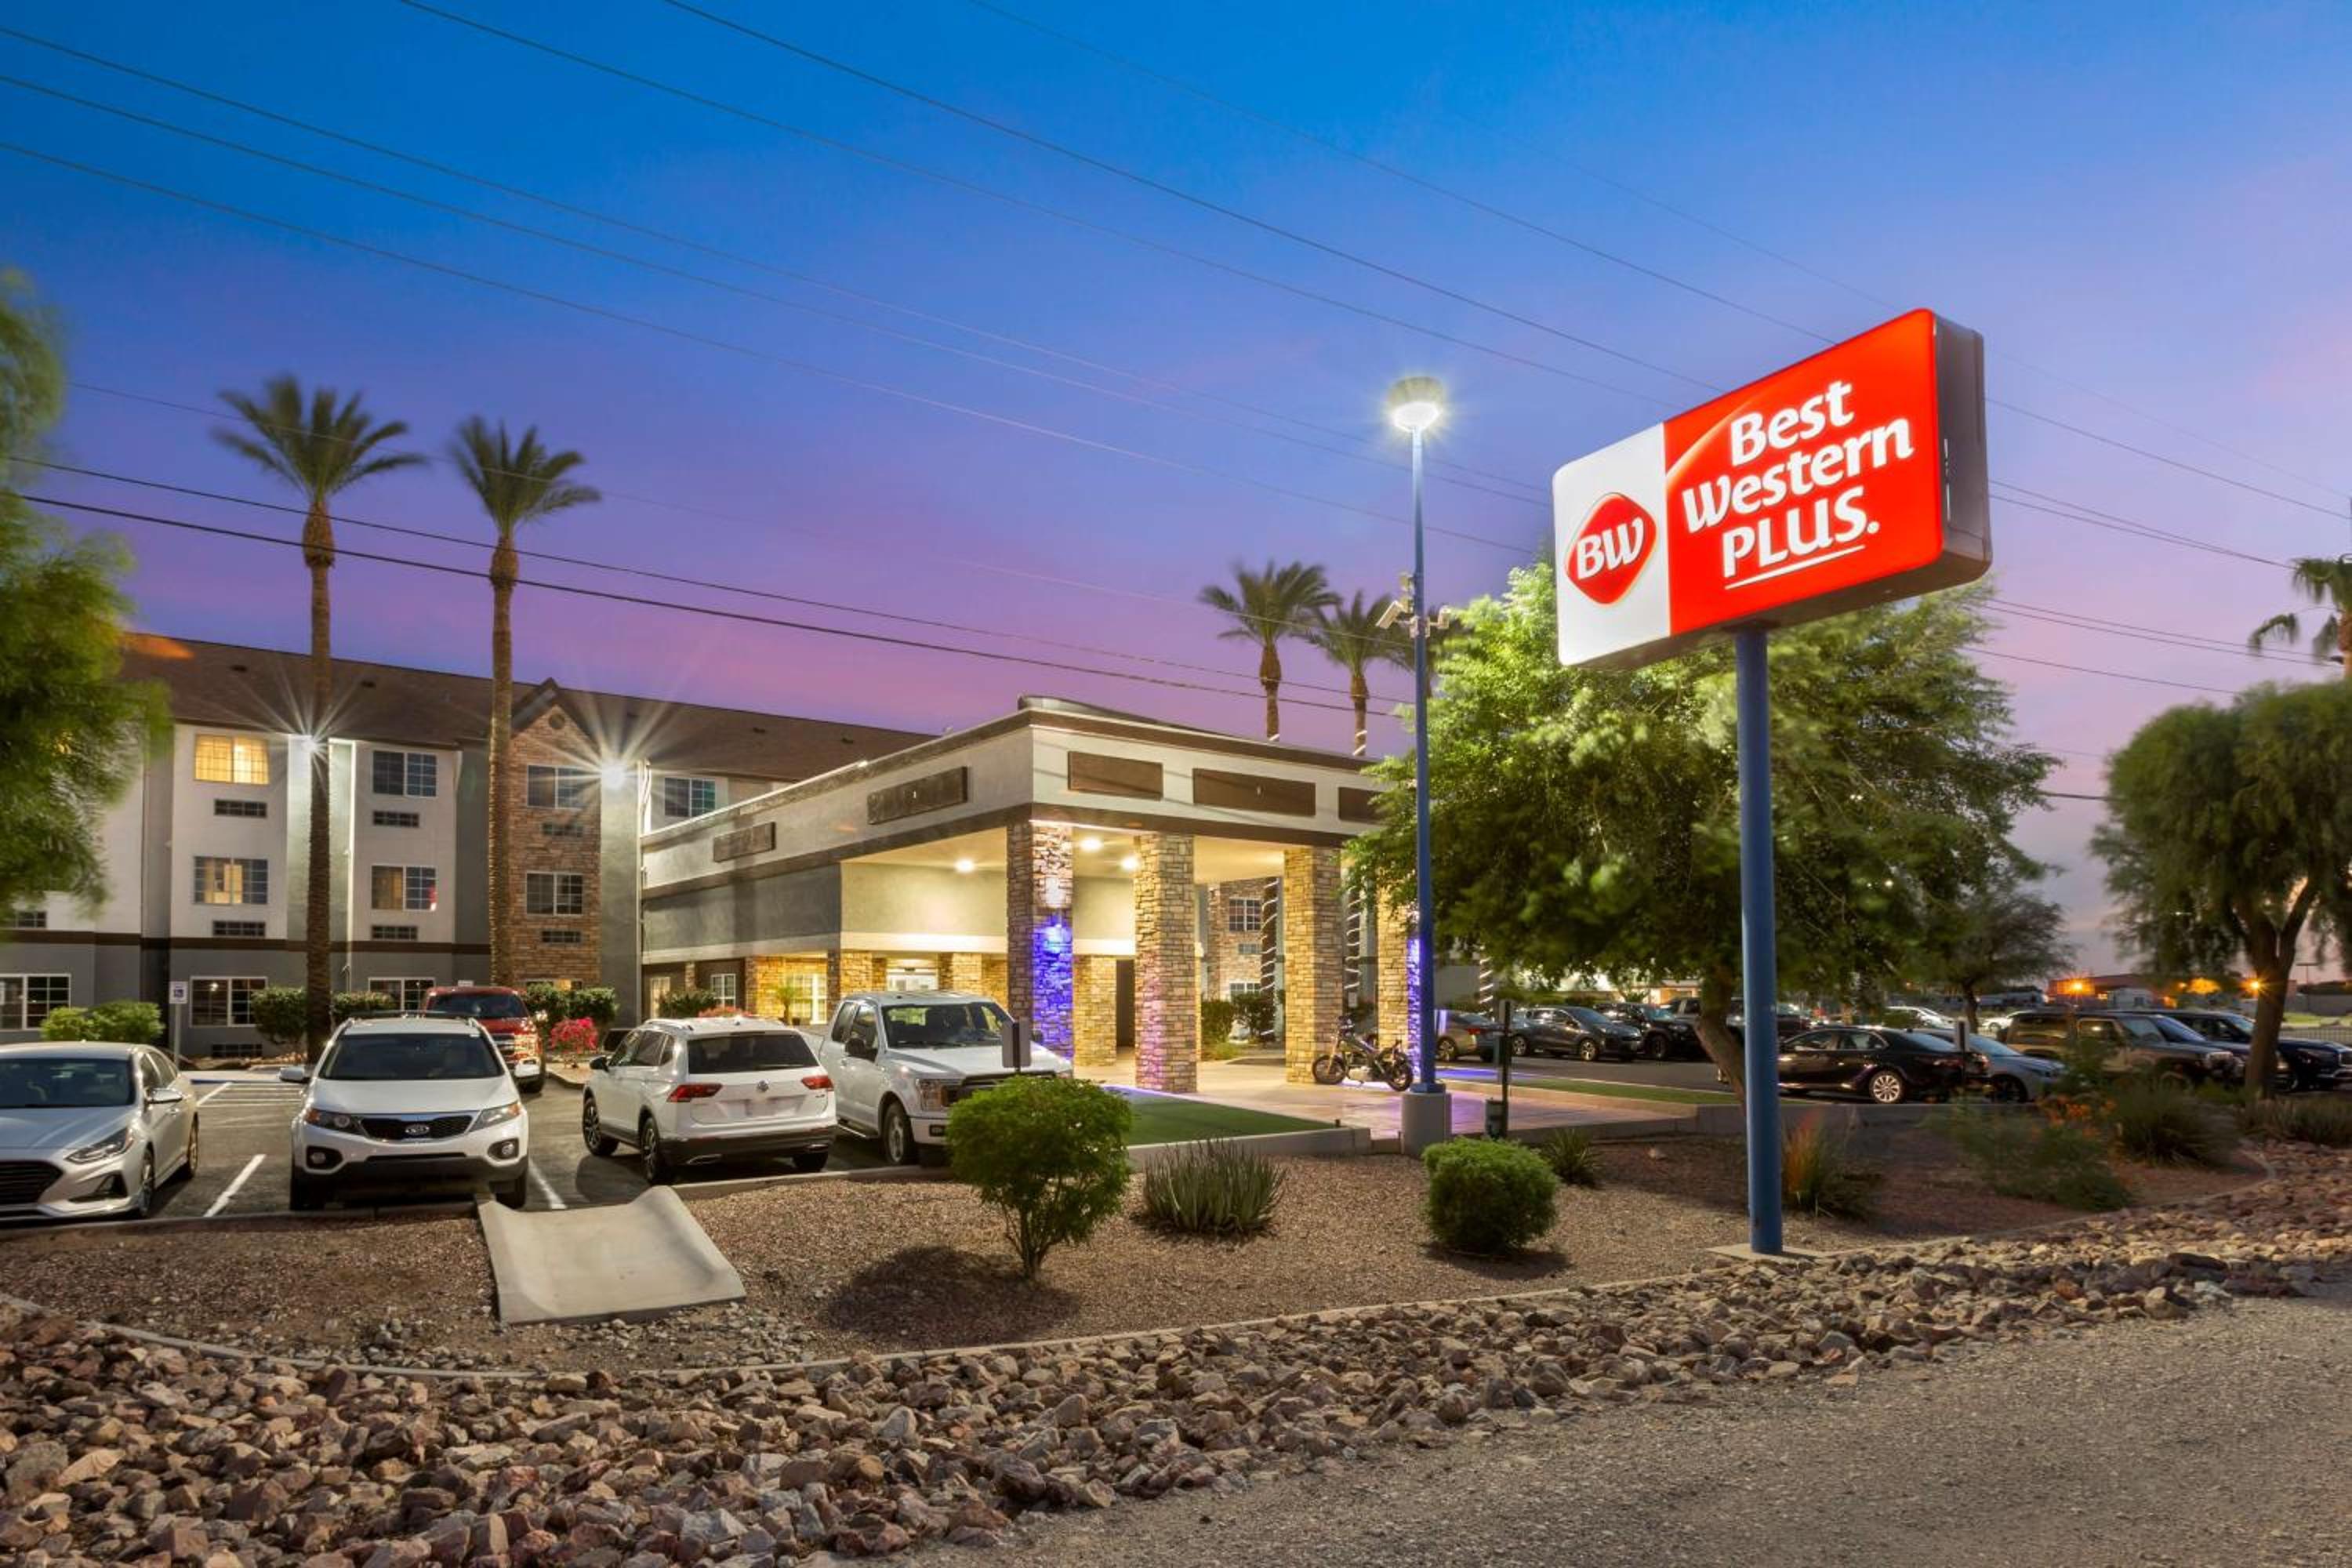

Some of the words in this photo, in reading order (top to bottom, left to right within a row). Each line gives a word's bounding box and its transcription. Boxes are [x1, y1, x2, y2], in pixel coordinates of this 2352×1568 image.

[1730, 381, 1854, 466] Best
[1682, 418, 1914, 533] Western
[1577, 517, 1644, 579] BW
